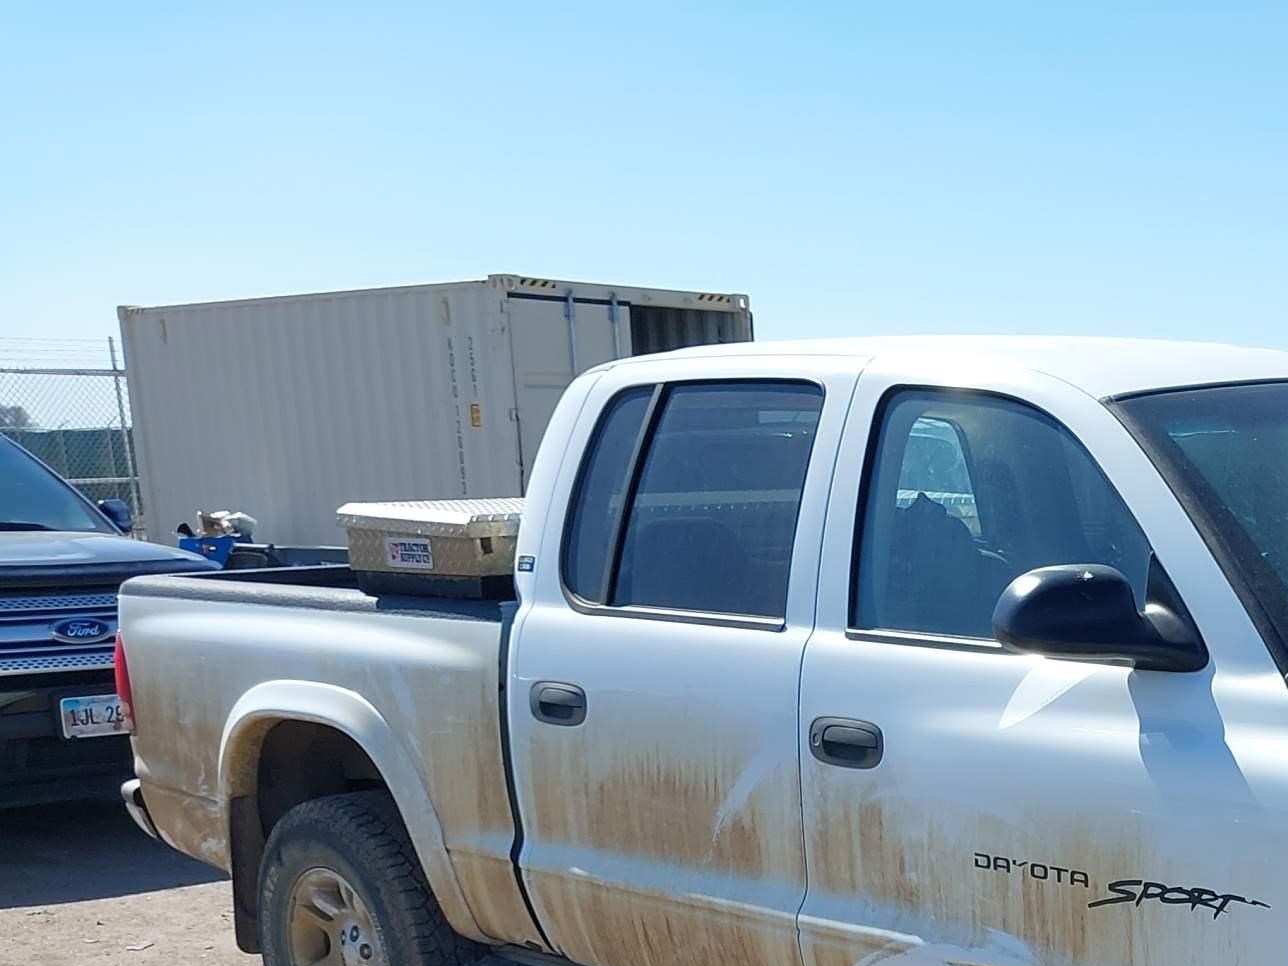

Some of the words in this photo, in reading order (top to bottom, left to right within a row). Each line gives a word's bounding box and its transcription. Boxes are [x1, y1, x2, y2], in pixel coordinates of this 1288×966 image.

[400, 542, 429, 552] TRACTOR
[400, 553, 421, 563] SUPPLY
[67, 622, 101, 636] Ford
[71, 707, 100, 727] 1JL
[1088, 879, 1271, 920] SPORT
